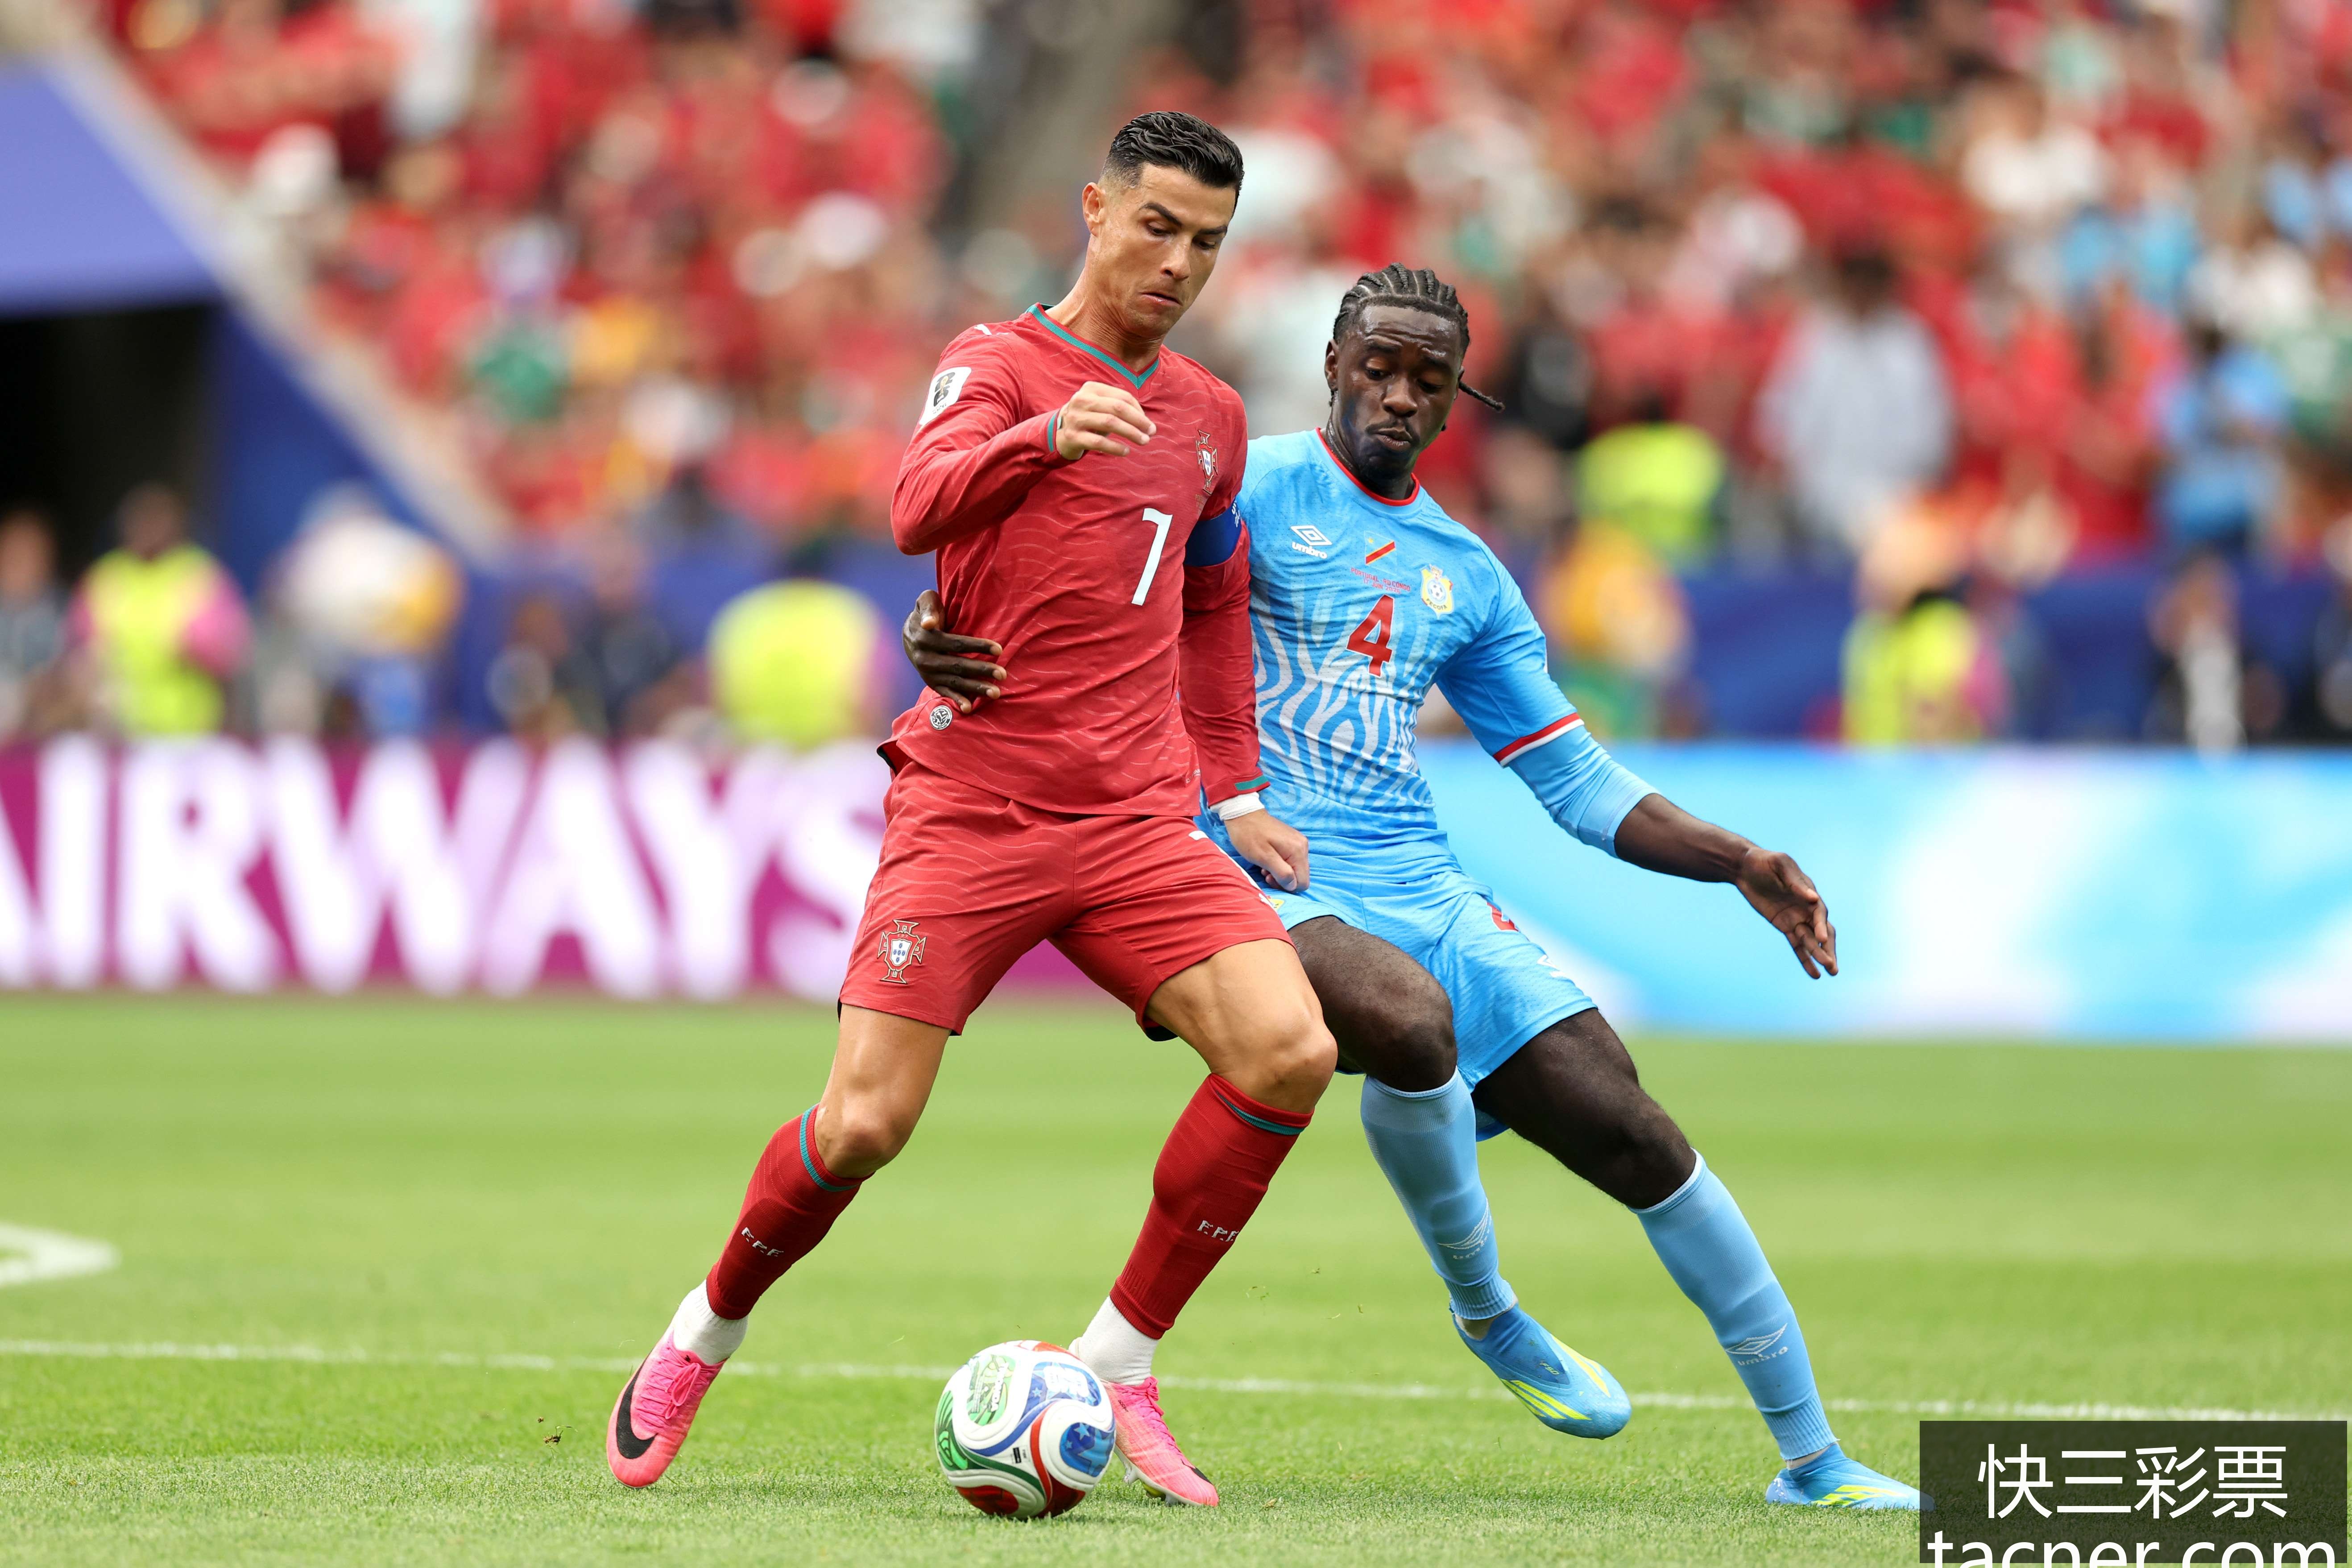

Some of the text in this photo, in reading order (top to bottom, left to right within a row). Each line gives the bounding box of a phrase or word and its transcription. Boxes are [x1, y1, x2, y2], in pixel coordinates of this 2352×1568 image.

[1131, 508, 1173, 606] 7
[1292, 541, 1328, 559] umbro
[1351, 567, 1379, 582] PORTUGAL
[1392, 581, 1410, 592] CONGO
[1346, 594, 1395, 677] 4
[0, 734, 888, 999] IRWAYS
